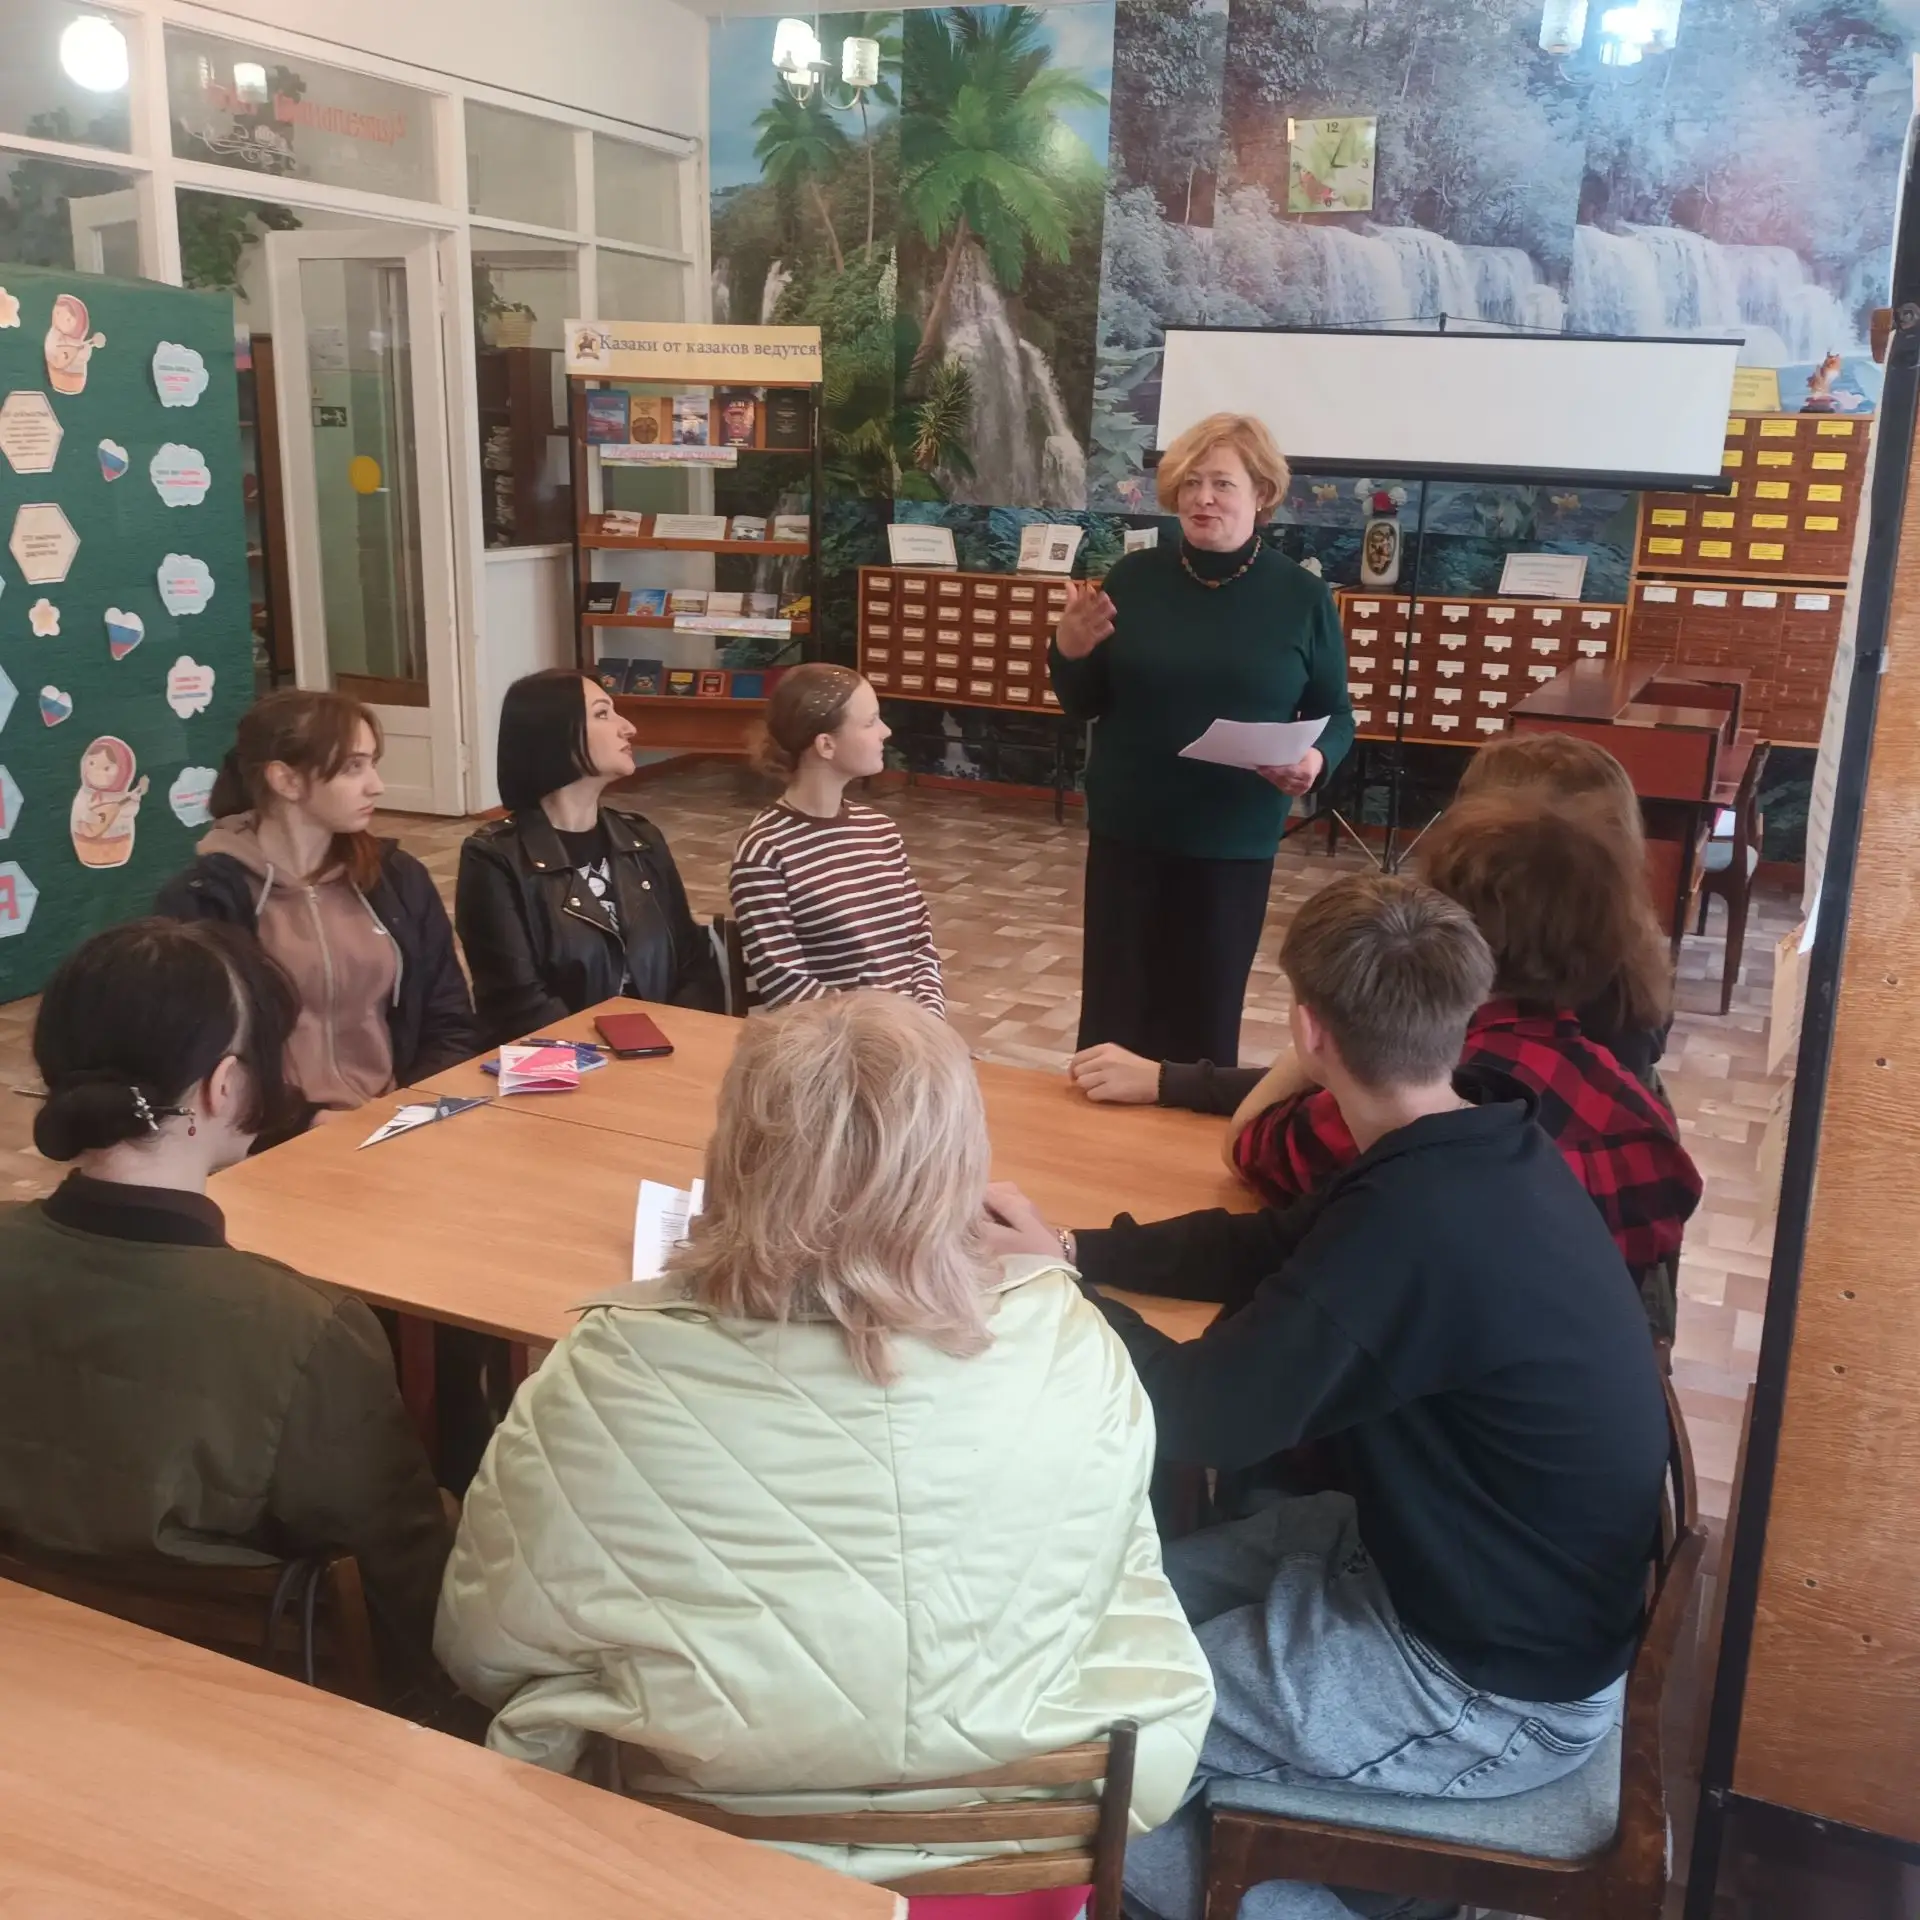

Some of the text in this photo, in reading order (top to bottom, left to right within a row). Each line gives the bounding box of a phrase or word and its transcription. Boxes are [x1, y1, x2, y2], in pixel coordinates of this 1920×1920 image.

[1326, 121, 1340, 133] 12
[1361, 158, 1369, 168] 3
[599, 334, 657, 352] Казаки
[662, 341, 681, 353] от
[686, 342, 749, 355] казаков
